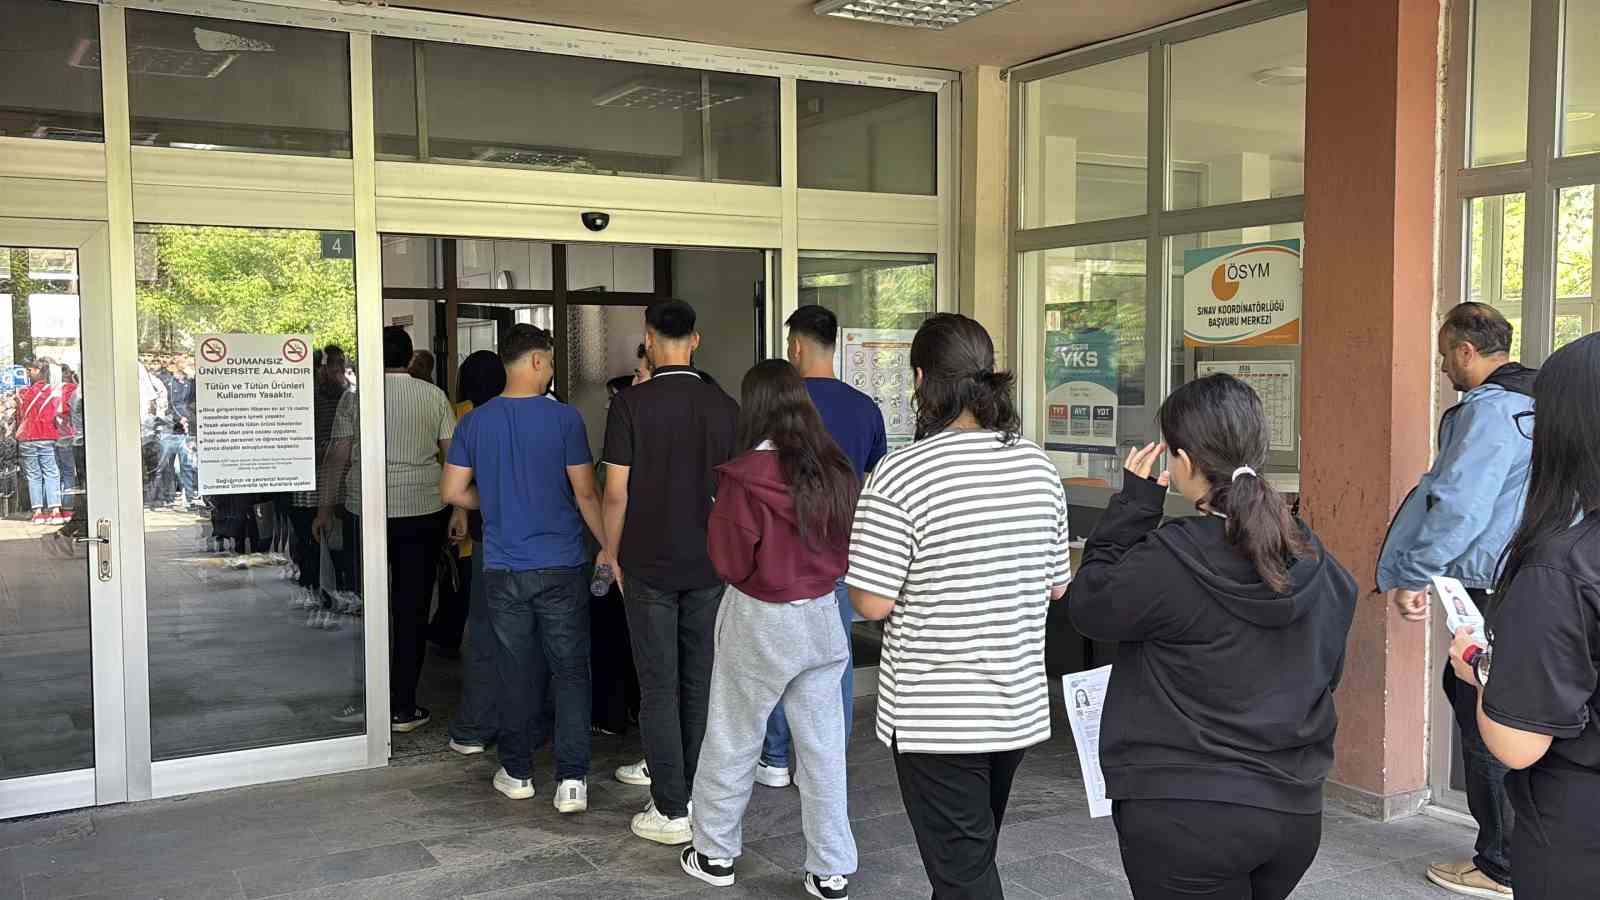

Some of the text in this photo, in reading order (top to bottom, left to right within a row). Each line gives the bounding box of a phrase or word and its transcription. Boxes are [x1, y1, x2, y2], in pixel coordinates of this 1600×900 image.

[332, 237, 342, 254] 4
[1227, 262, 1270, 280] ÖSYM
[1197, 305, 1216, 316] SINAV
[1208, 314, 1272, 328] BAŞVURU MERKEZİ
[1060, 351, 1099, 368] YKS
[263, 367, 311, 375] ALANIDIR
[205, 382, 230, 390] Tütün
[243, 382, 269, 390] Tütün
[271, 380, 305, 390] Ürünleri
[216, 391, 257, 399] Kullanımı
